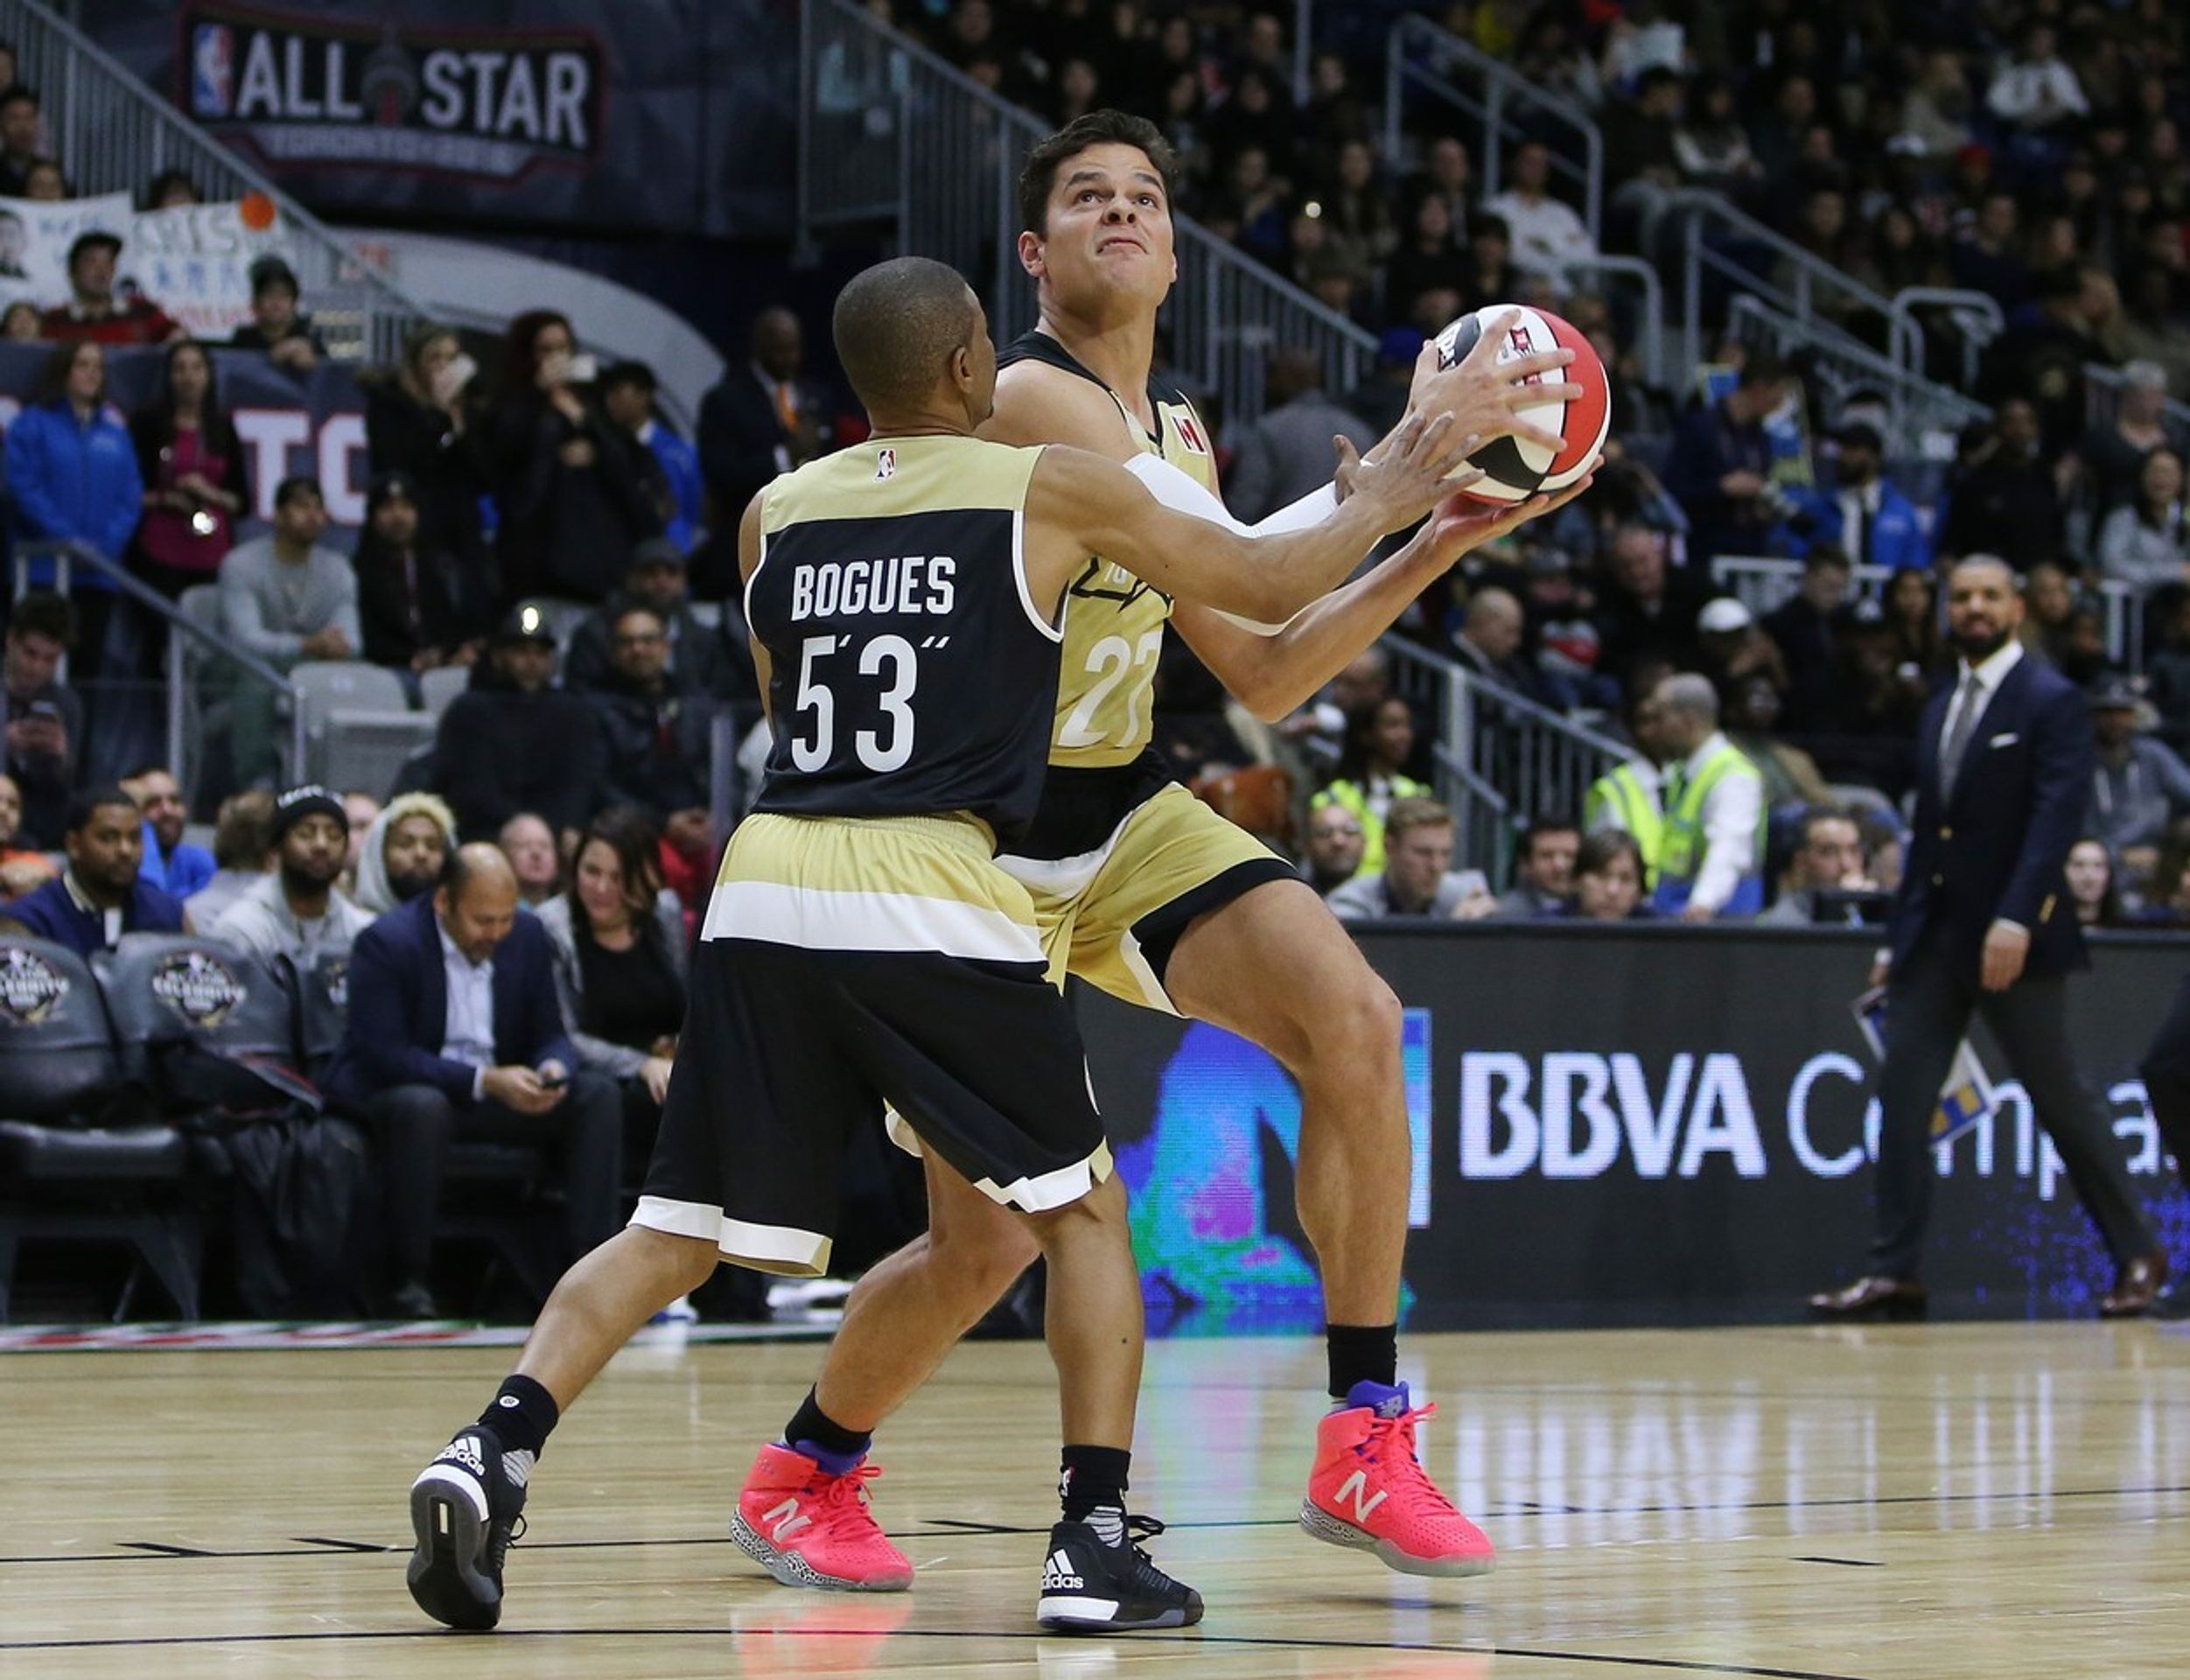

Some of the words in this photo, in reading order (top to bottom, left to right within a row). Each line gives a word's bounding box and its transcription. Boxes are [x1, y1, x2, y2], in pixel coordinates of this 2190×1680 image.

[235, 30, 363, 119] ALL
[422, 50, 591, 150] STAR
[791, 556, 956, 621] BOGUES
[1057, 630, 1164, 749] 27
[1459, 1051, 1767, 1180] BBVA
[1040, 1572, 1085, 1590] didas
